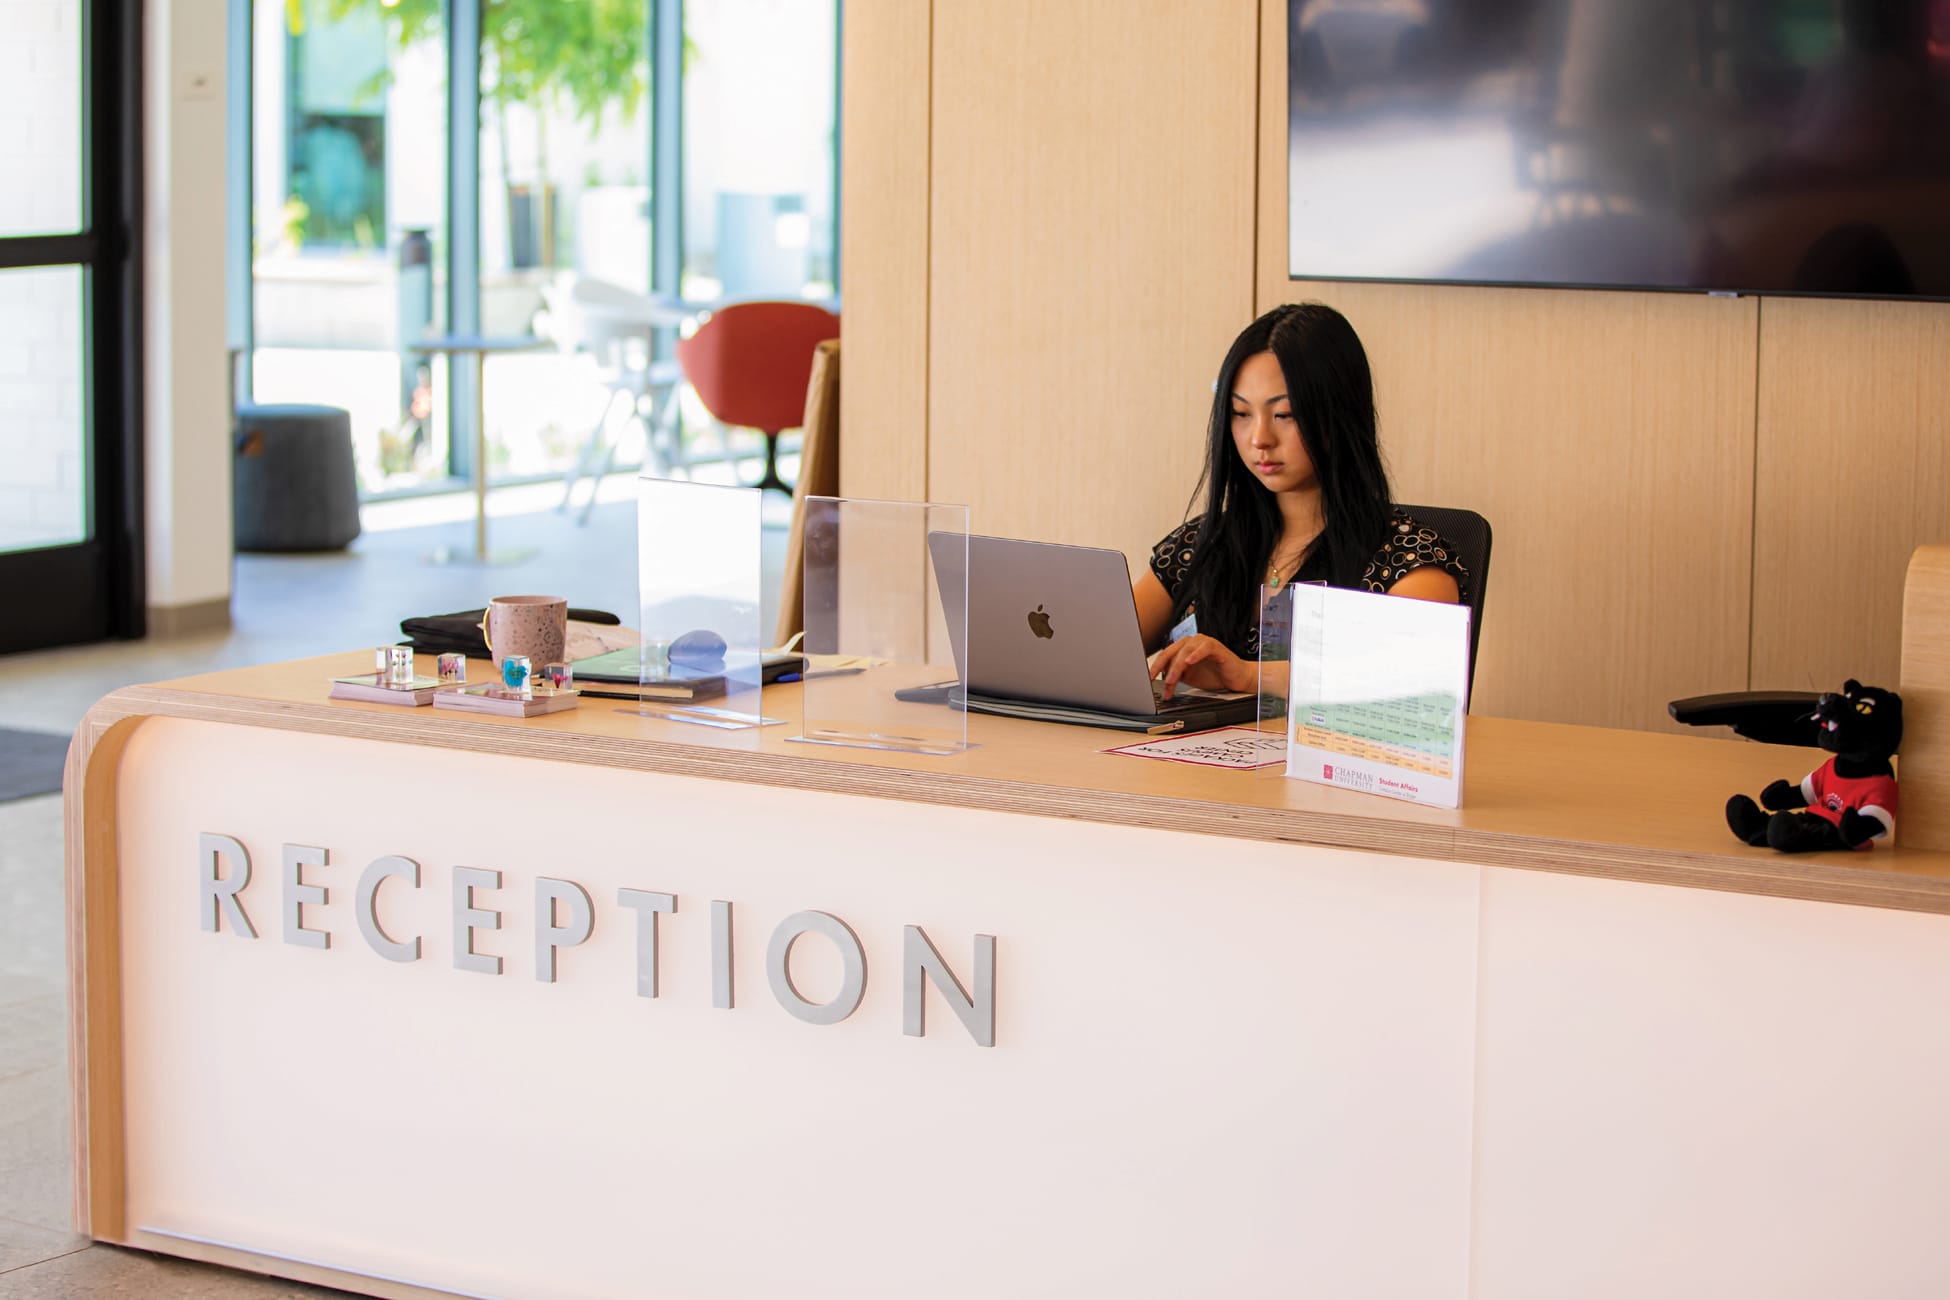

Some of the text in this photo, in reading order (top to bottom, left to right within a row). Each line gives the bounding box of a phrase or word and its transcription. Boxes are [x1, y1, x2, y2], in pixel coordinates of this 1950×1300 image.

[1334, 766, 1374, 783] CHAPMAN
[1334, 775, 1373, 790] UNIVERSITY
[1379, 777, 1399, 787] Student
[1400, 782, 1418, 792] Affairs
[199, 831, 998, 1048] RECEPTION
